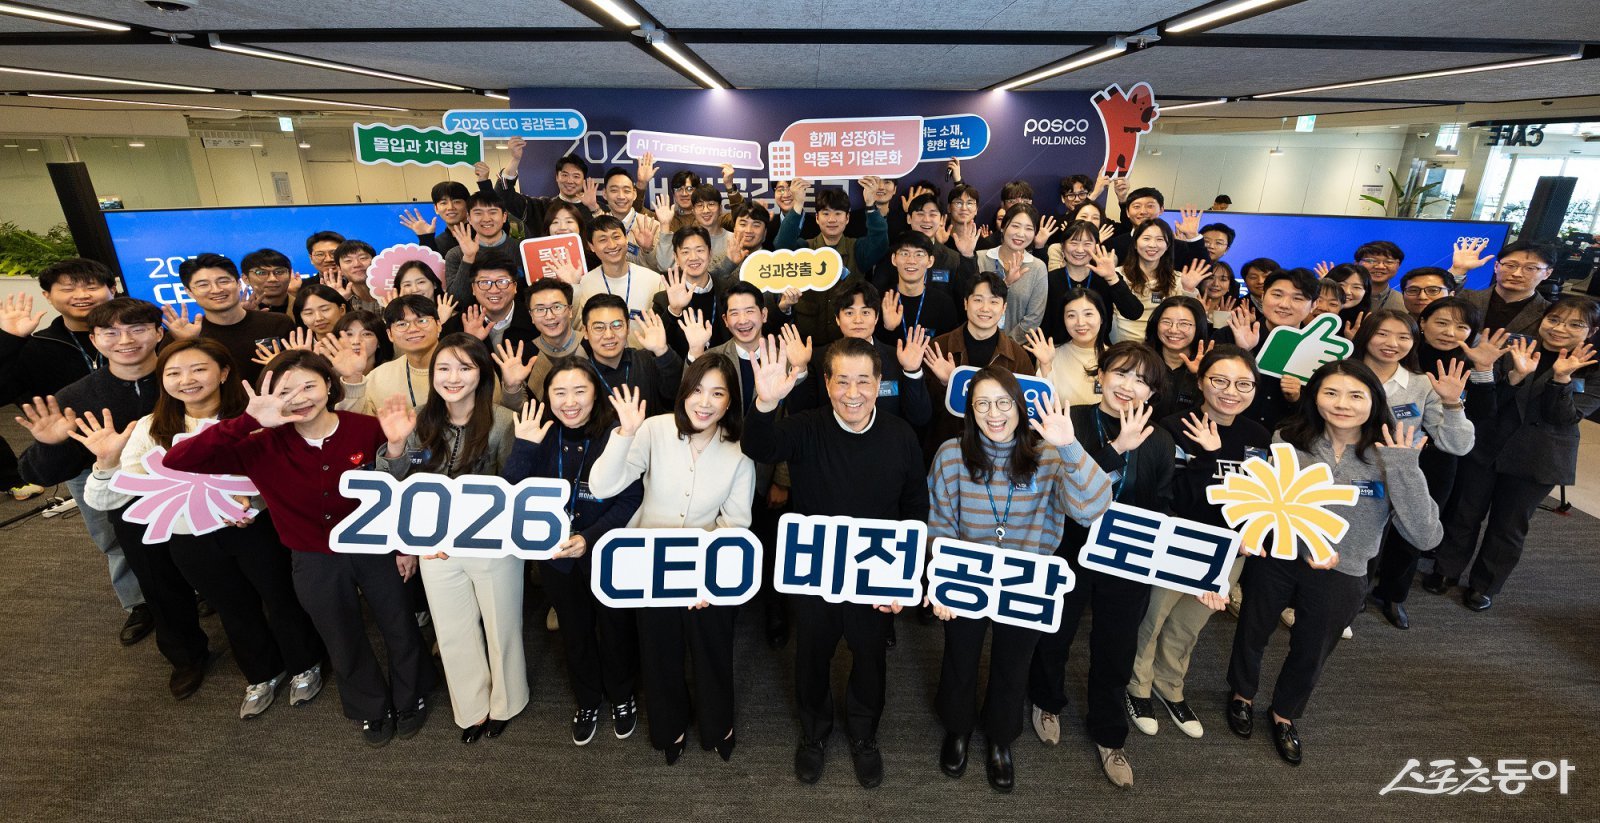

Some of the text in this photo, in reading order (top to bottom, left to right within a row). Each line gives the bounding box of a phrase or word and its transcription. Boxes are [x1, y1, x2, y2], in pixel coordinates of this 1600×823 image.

[452, 117, 568, 132] 2026 CEO 공감토크
[940, 124, 963, 137] 소재,
[1023, 118, 1089, 137] posco
[373, 136, 468, 157] 몰입과 치열함
[809, 130, 896, 148] 함께 성장하는
[927, 137, 971, 152] 향한 혁신
[1032, 135, 1087, 146] HOLDINGS
[636, 138, 752, 161] AI Transformation
[803, 150, 902, 167] 역동적 기업문화
[758, 260, 813, 279] 성과창출
[338, 478, 562, 551] 2026
[783, 522, 919, 598] 비전
[1086, 508, 1232, 593] 토크
[599, 536, 755, 600] CEO
[934, 544, 1068, 627] 공감
